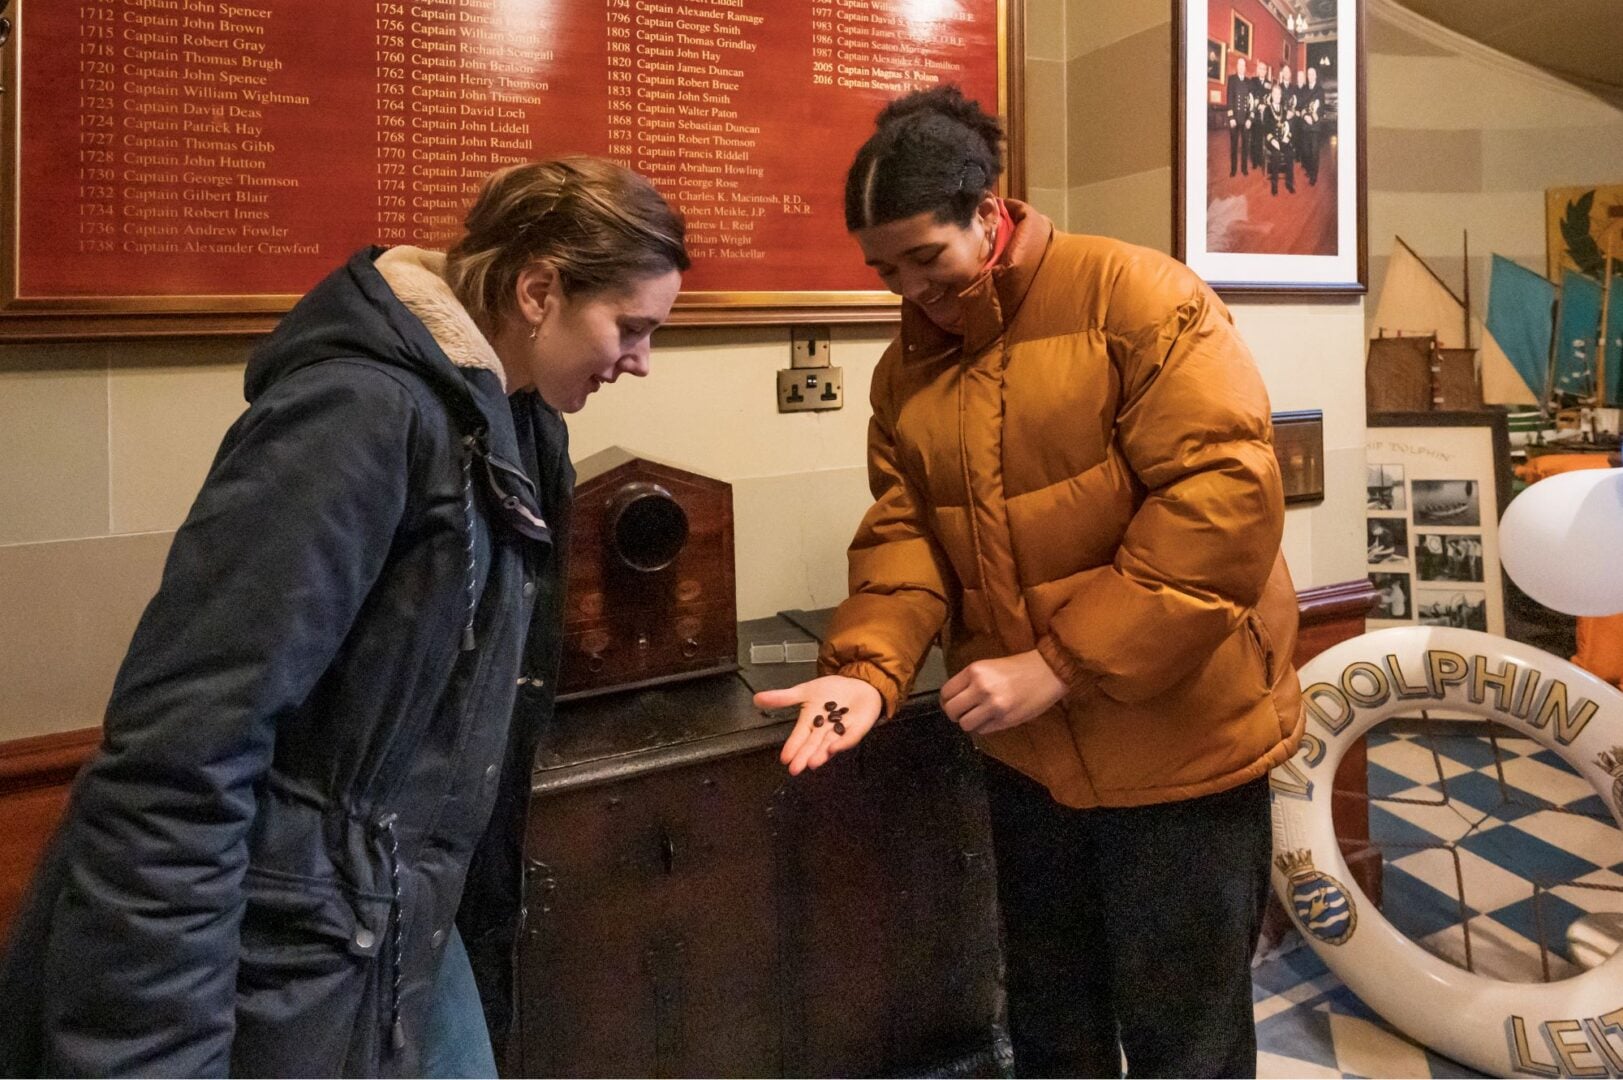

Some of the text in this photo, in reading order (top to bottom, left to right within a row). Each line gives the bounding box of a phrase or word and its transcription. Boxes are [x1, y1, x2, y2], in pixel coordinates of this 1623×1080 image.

[183, 0, 272, 18] John Spencer
[376, 3, 404, 16] 1754
[411, 6, 456, 21] Captain
[636, 1, 673, 14] Captain
[676, 6, 725, 20] Alexander
[727, 11, 764, 25] Ramage
[812, 7, 832, 18] 1977
[836, 11, 869, 22] Captain
[80, 8, 264, 34] 1712 Captain John Brown
[376, 19, 456, 37] 1756 Captain
[606, 12, 740, 35] 1796 Captain George Smith
[80, 25, 266, 54] 1715 Captain Robert Gray
[376, 35, 456, 52] 1758 Captain
[607, 27, 757, 52] 1805 Captain Thomas Grindlay
[80, 43, 282, 71] 1718 Captain Thomas Brugh
[376, 51, 486, 70] 1760 Captain John
[607, 41, 721, 63] 1808 Captain John Hay
[80, 61, 268, 85] 1720 Captain John Spence
[607, 56, 744, 77] 1820 Captain James Duncan
[837, 64, 870, 76] Captain
[871, 67, 902, 80] Magnus
[913, 70, 939, 82] Polson
[376, 67, 549, 91] 1762 Captain Henry Thomson
[607, 71, 739, 91] 1830 Captain Robert Bruce
[813, 74, 833, 85] 2016
[837, 77, 870, 89] Captain
[871, 80, 901, 91] Stewart
[80, 79, 309, 104] 1720 Captain William Wightman
[377, 83, 541, 105] 1763 Captain John Thomson
[608, 86, 730, 104] 1833 Captain John Smith
[80, 97, 262, 118] 1723 Captain David Deas
[377, 99, 526, 119] 1764 Captain David Loch
[608, 100, 738, 119] 1856 Captain Walter Paton
[80, 115, 262, 138] 1724 Captain Patrick Hay
[377, 115, 529, 134] 1766 Captain John Liddell
[608, 115, 760, 134] 1868 Captain Sebastian Duncan
[80, 132, 275, 153] 1727 Captain Thomas Gibb
[377, 131, 532, 150] 1768 Captain John Randall
[608, 130, 756, 147] 1873 Captain Robert Thomson
[80, 150, 266, 169] 1728 Captain John Hutton
[378, 147, 528, 164] 1770 Captain John Brown
[608, 144, 749, 161] 1888 Captain Francis Riddell
[124, 170, 178, 184] Captain
[184, 172, 233, 187] George
[237, 174, 299, 187] Thomson
[378, 163, 458, 179] 1772 Captain
[638, 160, 676, 173] Captain
[679, 162, 722, 174] Abraham
[724, 164, 764, 178] Howling
[678, 176, 739, 189] George Rose
[184, 190, 269, 203] Gilbert Blair
[678, 191, 715, 201] Charles
[184, 207, 269, 219] Robert Innes
[680, 205, 711, 216] Robert
[243, 226, 288, 237] Fowler
[720, 235, 752, 247] Wright
[258, 242, 320, 254] Crawford
[1301, 650, 1599, 745] DOLPHIN
